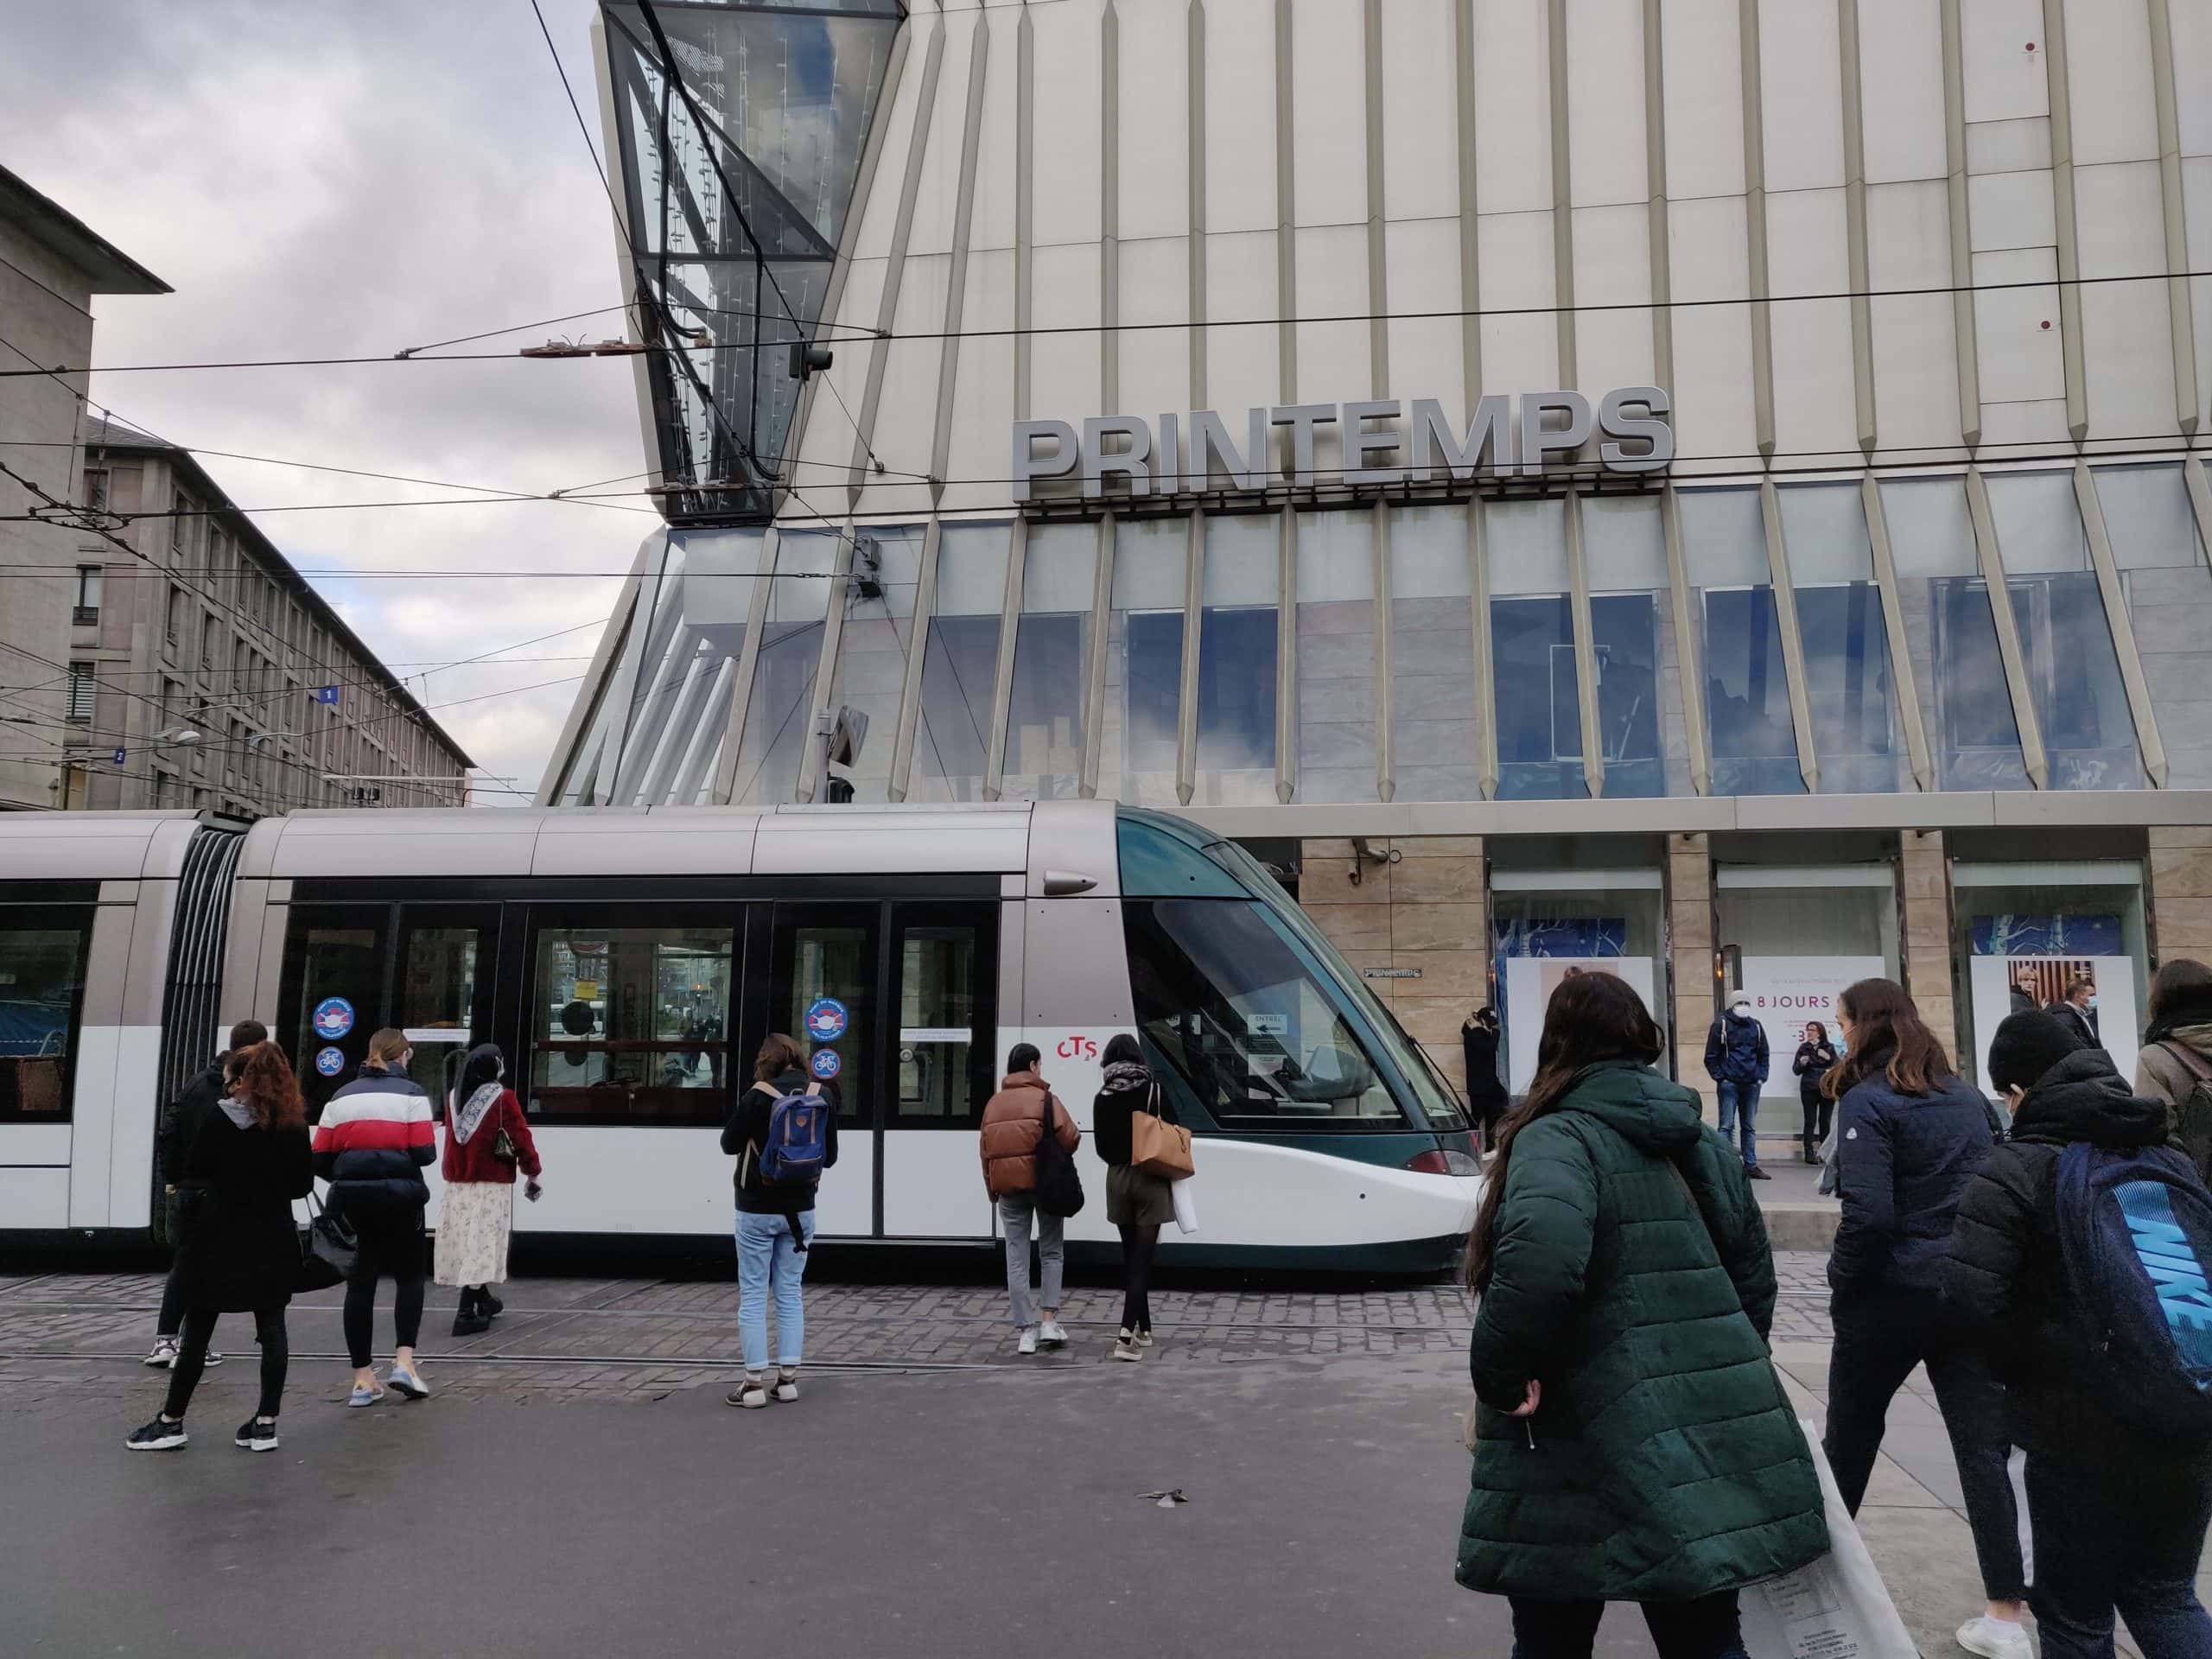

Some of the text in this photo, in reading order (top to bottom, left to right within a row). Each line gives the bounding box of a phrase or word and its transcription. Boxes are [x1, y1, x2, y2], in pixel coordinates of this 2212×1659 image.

[1013, 385, 1675, 503] PRINTEMPS
[324, 690, 332, 699] 1
[1758, 996, 1765, 1007] 8
[1772, 996, 1830, 1007] JOURS
